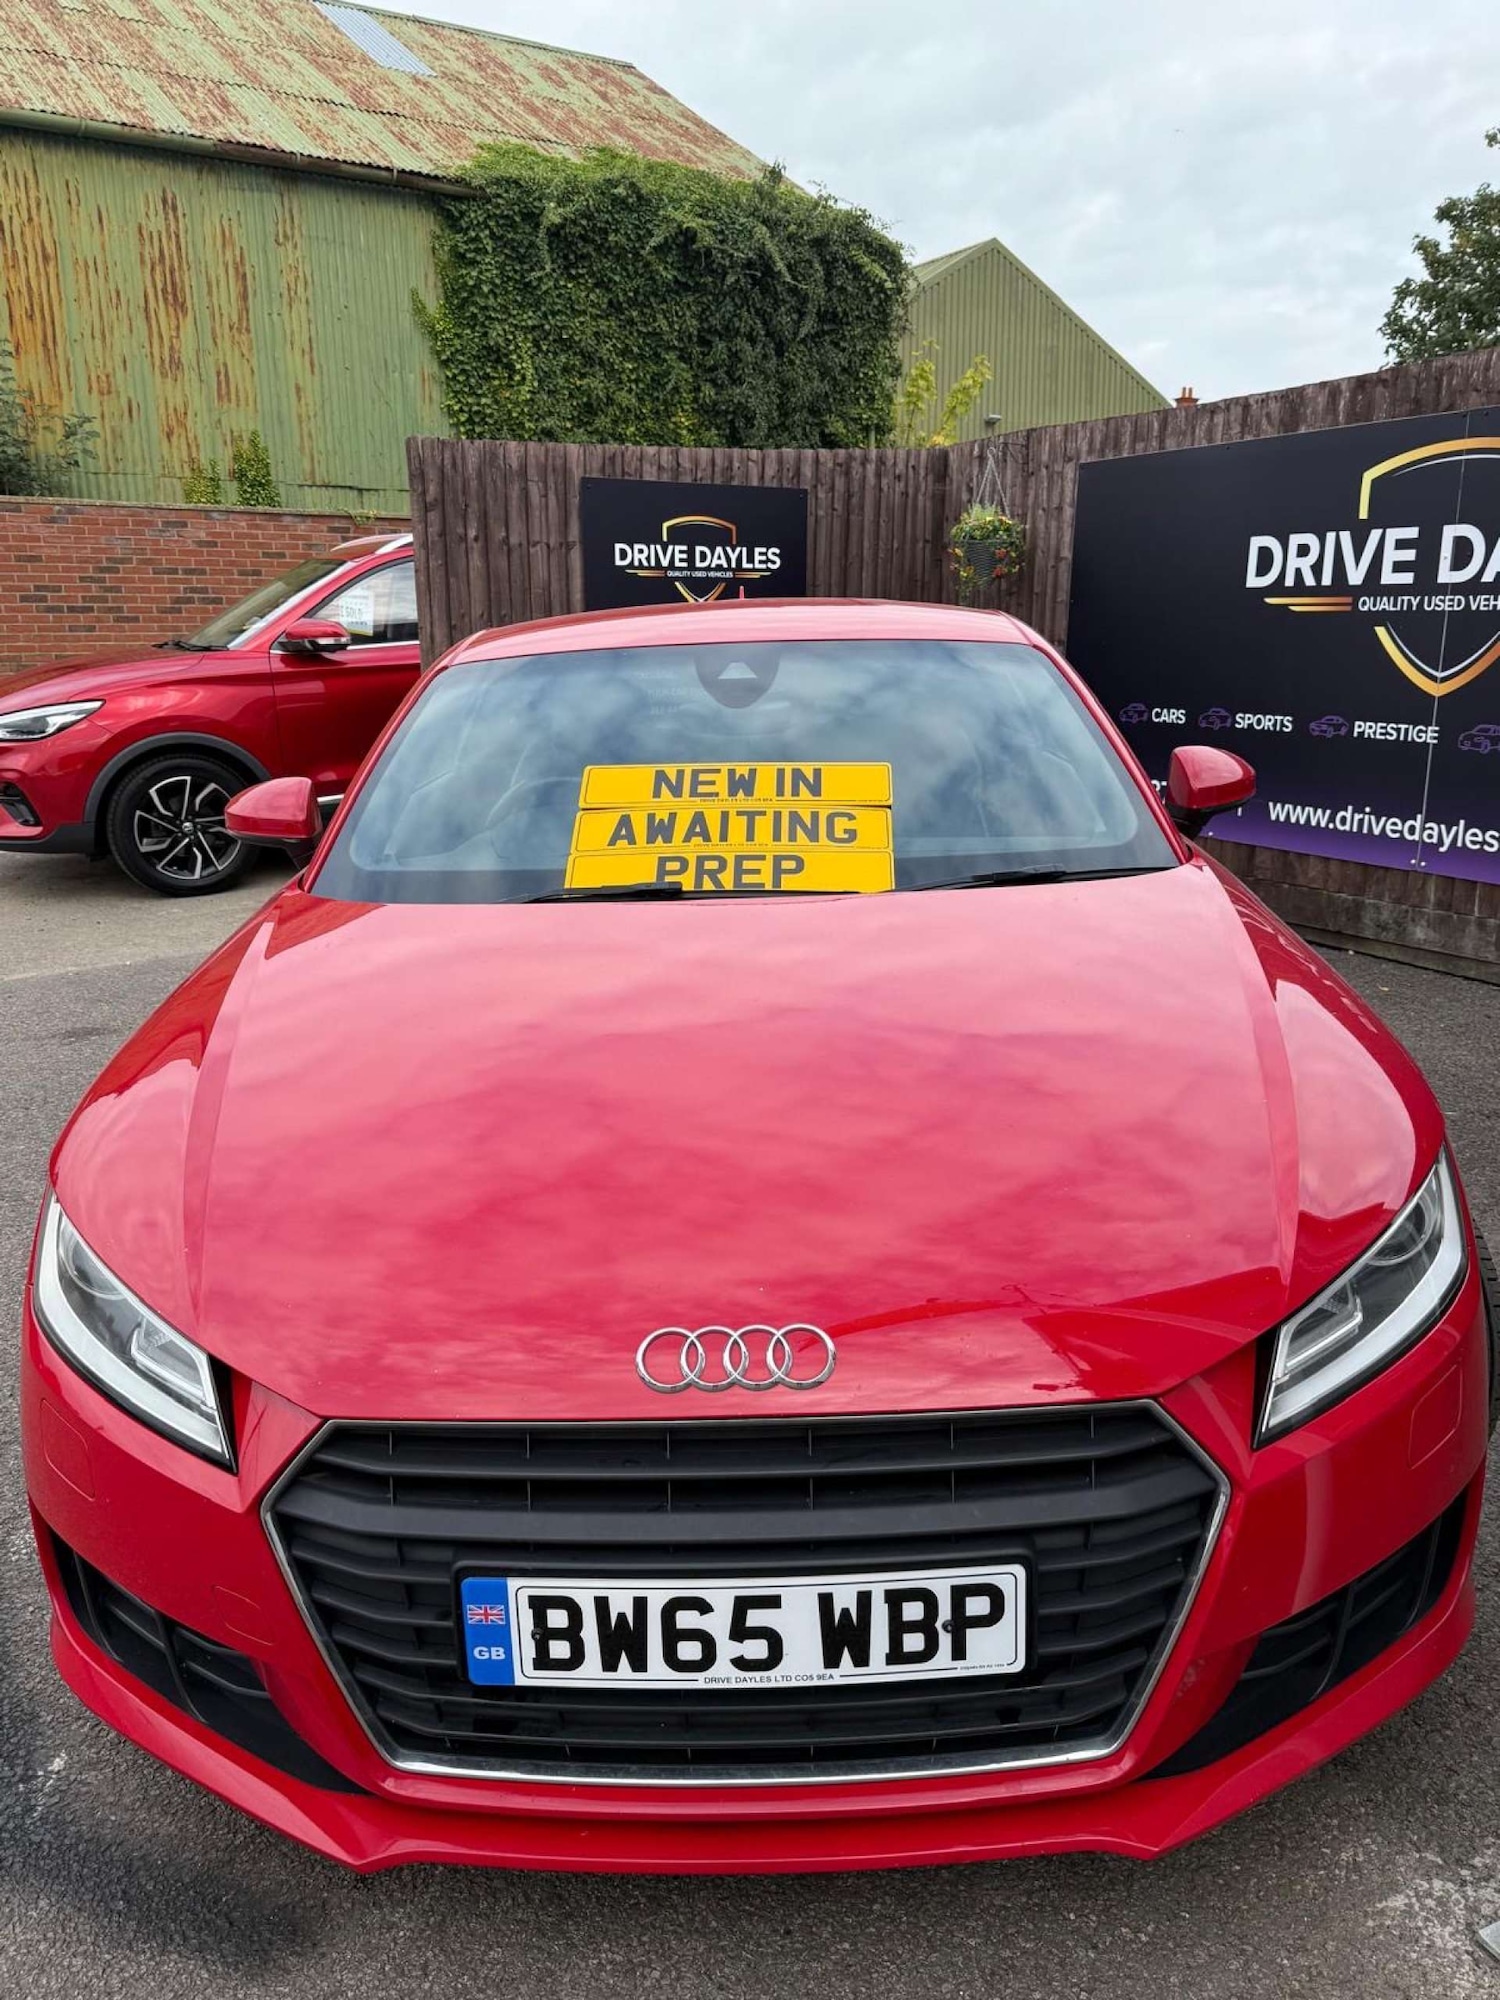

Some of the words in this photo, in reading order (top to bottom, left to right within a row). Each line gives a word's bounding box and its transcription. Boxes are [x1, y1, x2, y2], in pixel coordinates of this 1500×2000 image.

[613, 543, 688, 568] DRIVE
[694, 545, 781, 570] DAYLES
[1245, 526, 1420, 588] DRIVE
[1358, 596, 1420, 611] QUALITY
[1424, 596, 1465, 611] USED
[1151, 708, 1186, 724] CARS
[1234, 713, 1293, 733] SPORTS
[1352, 721, 1440, 744] PRESTIGE
[652, 768, 757, 799] NEW
[775, 767, 822, 798] IN
[607, 810, 858, 847] AWAITING
[655, 854, 805, 890] PREP
[528, 1594, 784, 1674] BW65
[817, 1583, 1006, 1670] WBP
[473, 1646, 506, 1660] GB
[704, 1676, 733, 1685] DRIVE
[735, 1675, 772, 1684] DAYLES
[775, 1674, 792, 1683] LTD
